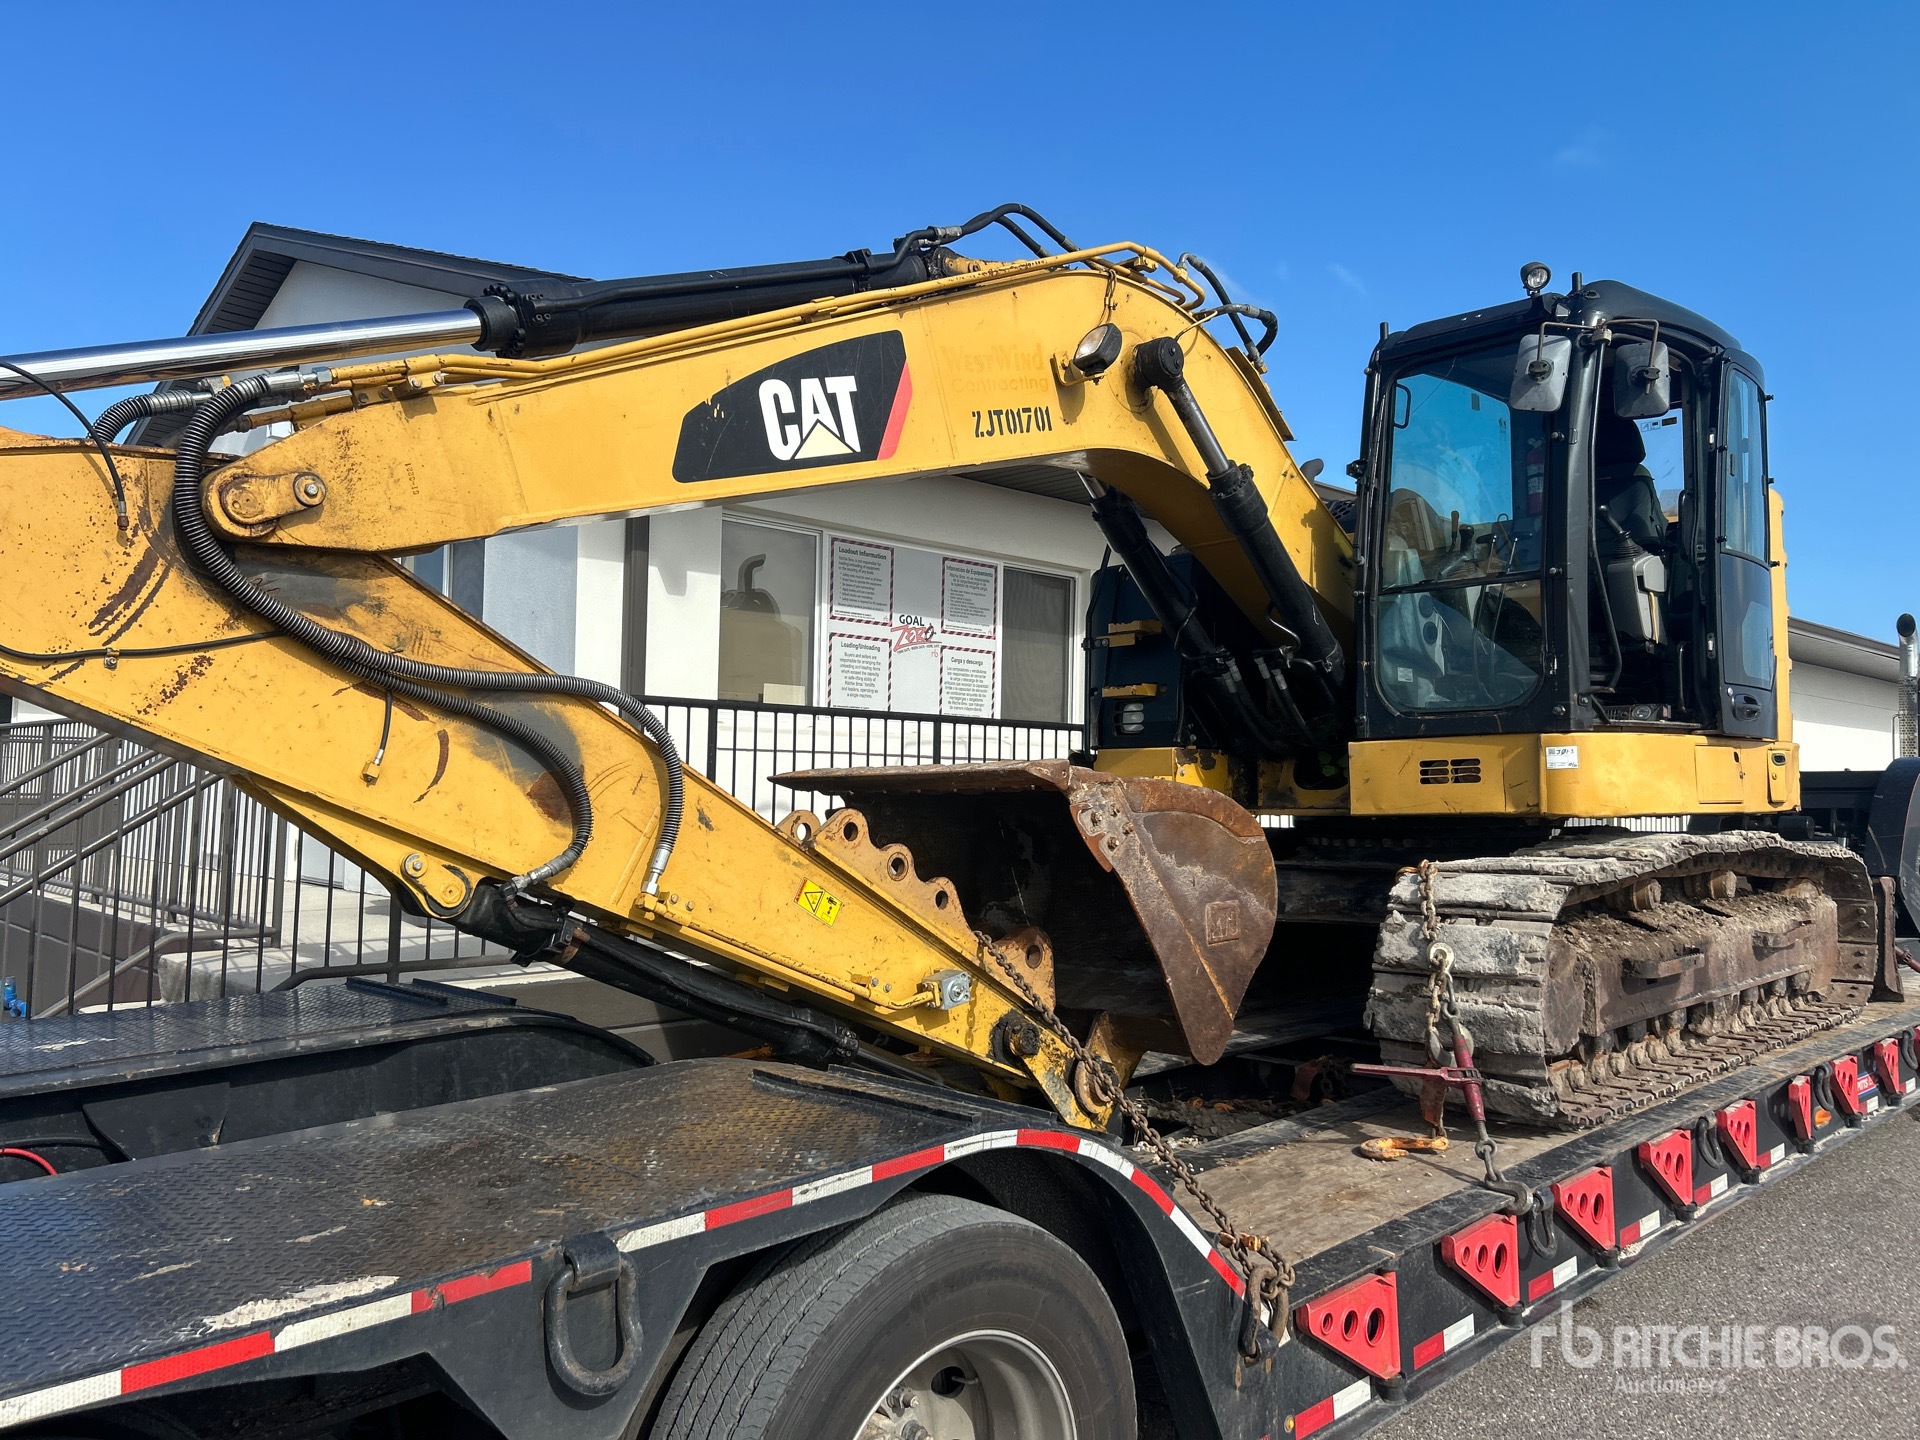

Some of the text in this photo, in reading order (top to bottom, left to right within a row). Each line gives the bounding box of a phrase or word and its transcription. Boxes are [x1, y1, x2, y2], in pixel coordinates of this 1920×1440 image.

[758, 374, 862, 461] CAT
[972, 406, 1052, 438] ZJT01701
[839, 547, 886, 560] Loadout Information
[899, 614, 925, 626] GOAL
[841, 642, 880, 652] Loading/Unloading
